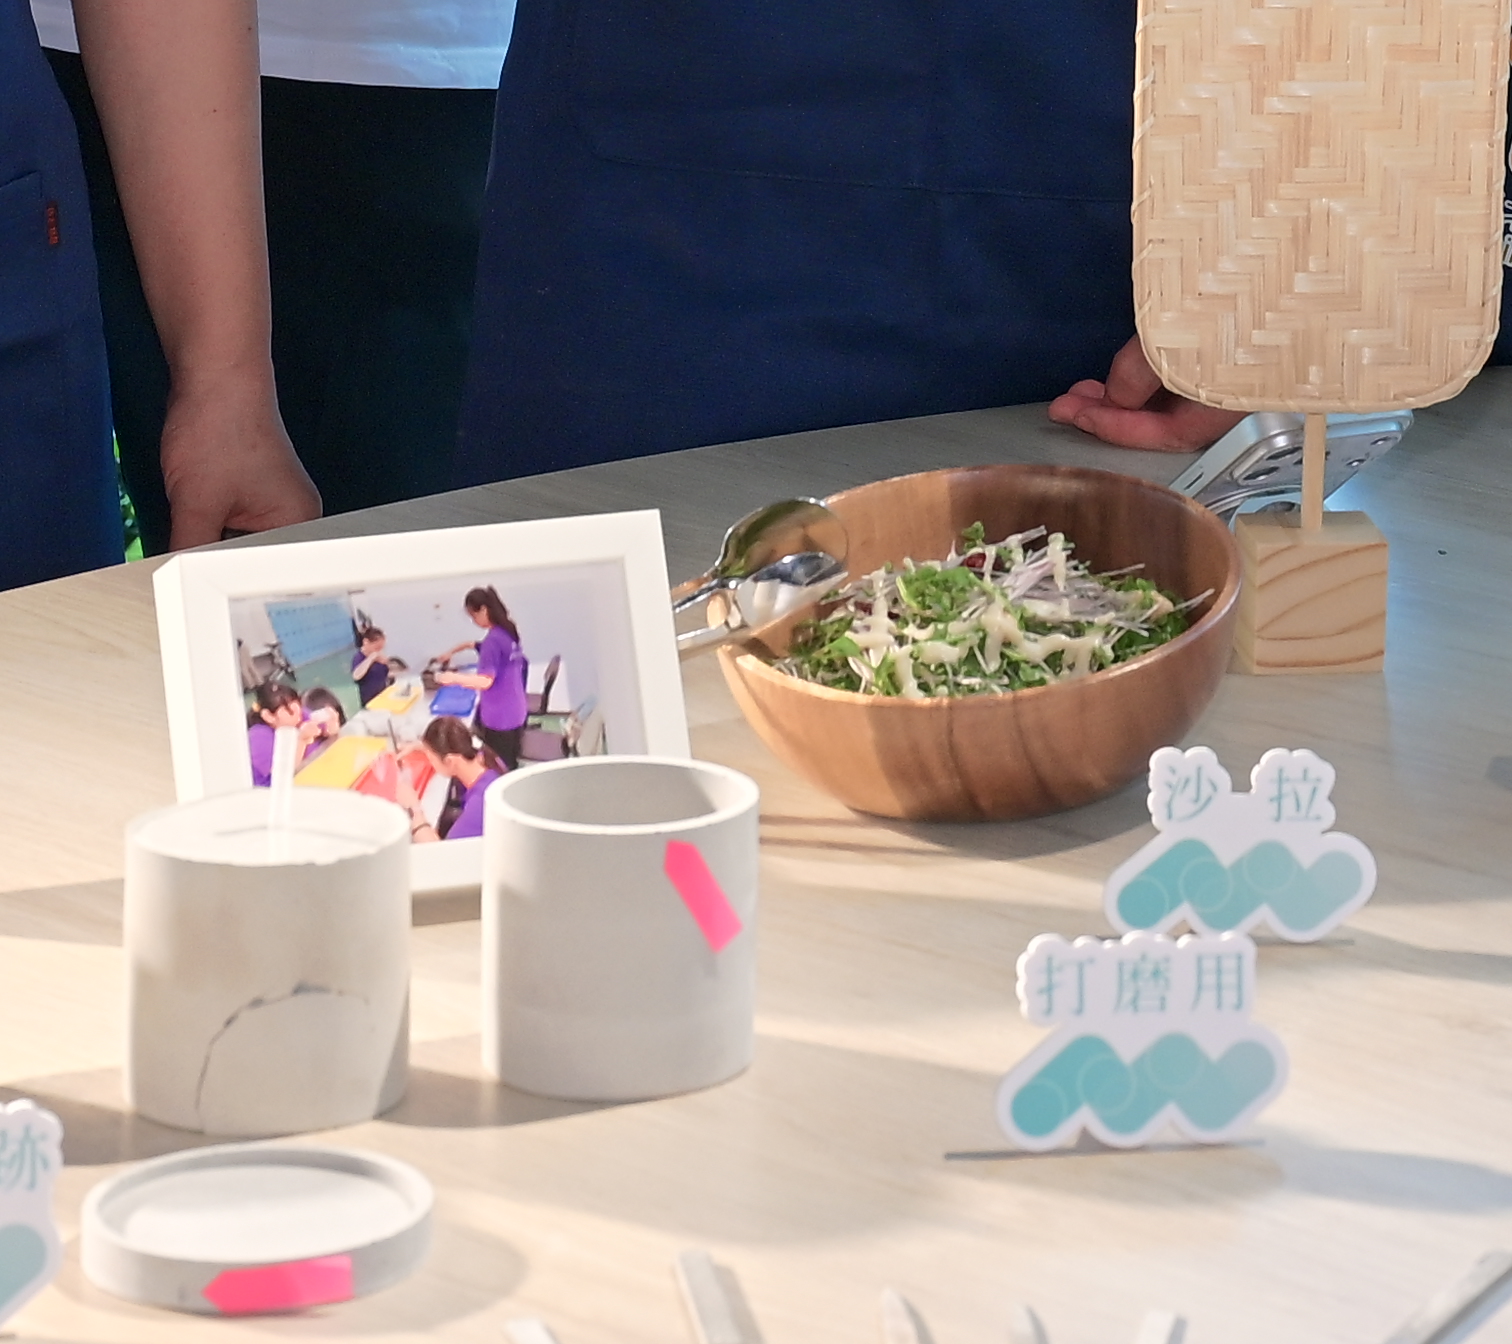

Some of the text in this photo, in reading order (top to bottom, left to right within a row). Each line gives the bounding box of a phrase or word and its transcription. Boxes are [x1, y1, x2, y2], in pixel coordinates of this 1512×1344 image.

[1164, 764, 1323, 823] 沙拉
[1038, 950, 1246, 1017] 打磨用
